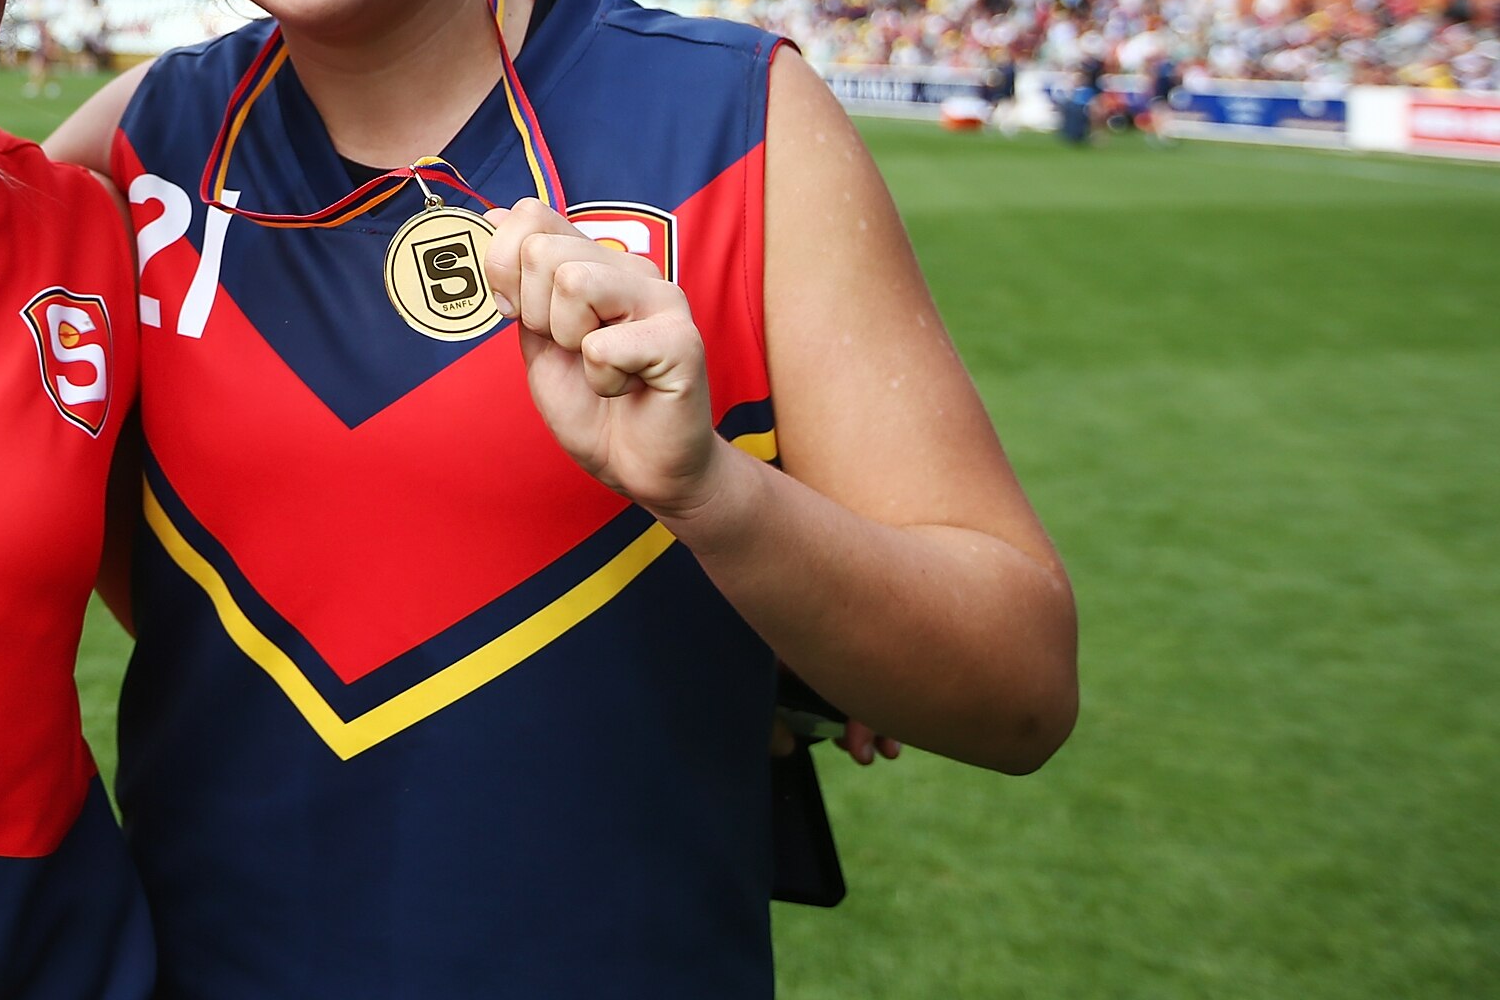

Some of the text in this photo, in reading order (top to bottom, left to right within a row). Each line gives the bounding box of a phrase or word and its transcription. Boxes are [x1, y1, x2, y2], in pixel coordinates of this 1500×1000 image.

[422, 242, 478, 304] S
[442, 299, 474, 312] SANFL
[46, 303, 107, 406] S
